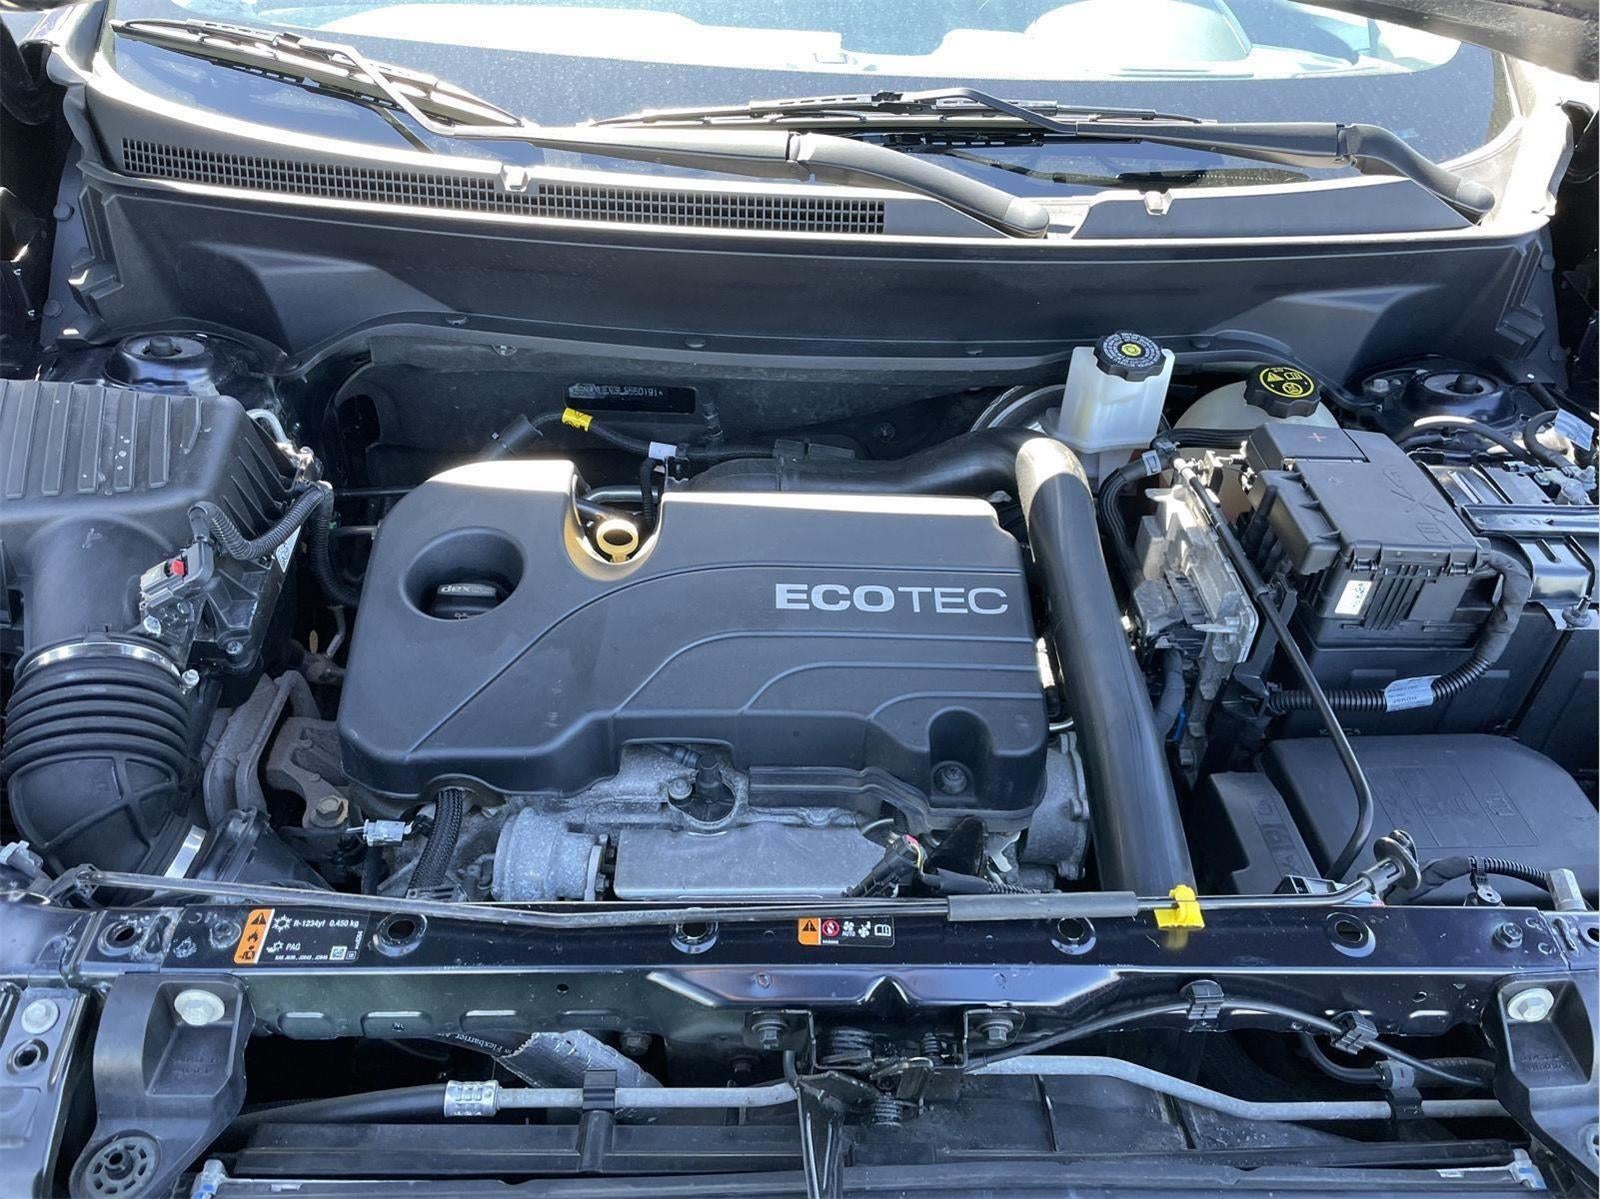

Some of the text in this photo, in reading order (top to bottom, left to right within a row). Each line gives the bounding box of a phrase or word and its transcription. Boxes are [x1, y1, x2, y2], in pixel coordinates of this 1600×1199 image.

[775, 583, 1009, 615] ECOTEC
[293, 919, 360, 928] R-1234yf 0.450 kg
[285, 942, 301, 951] PAG
